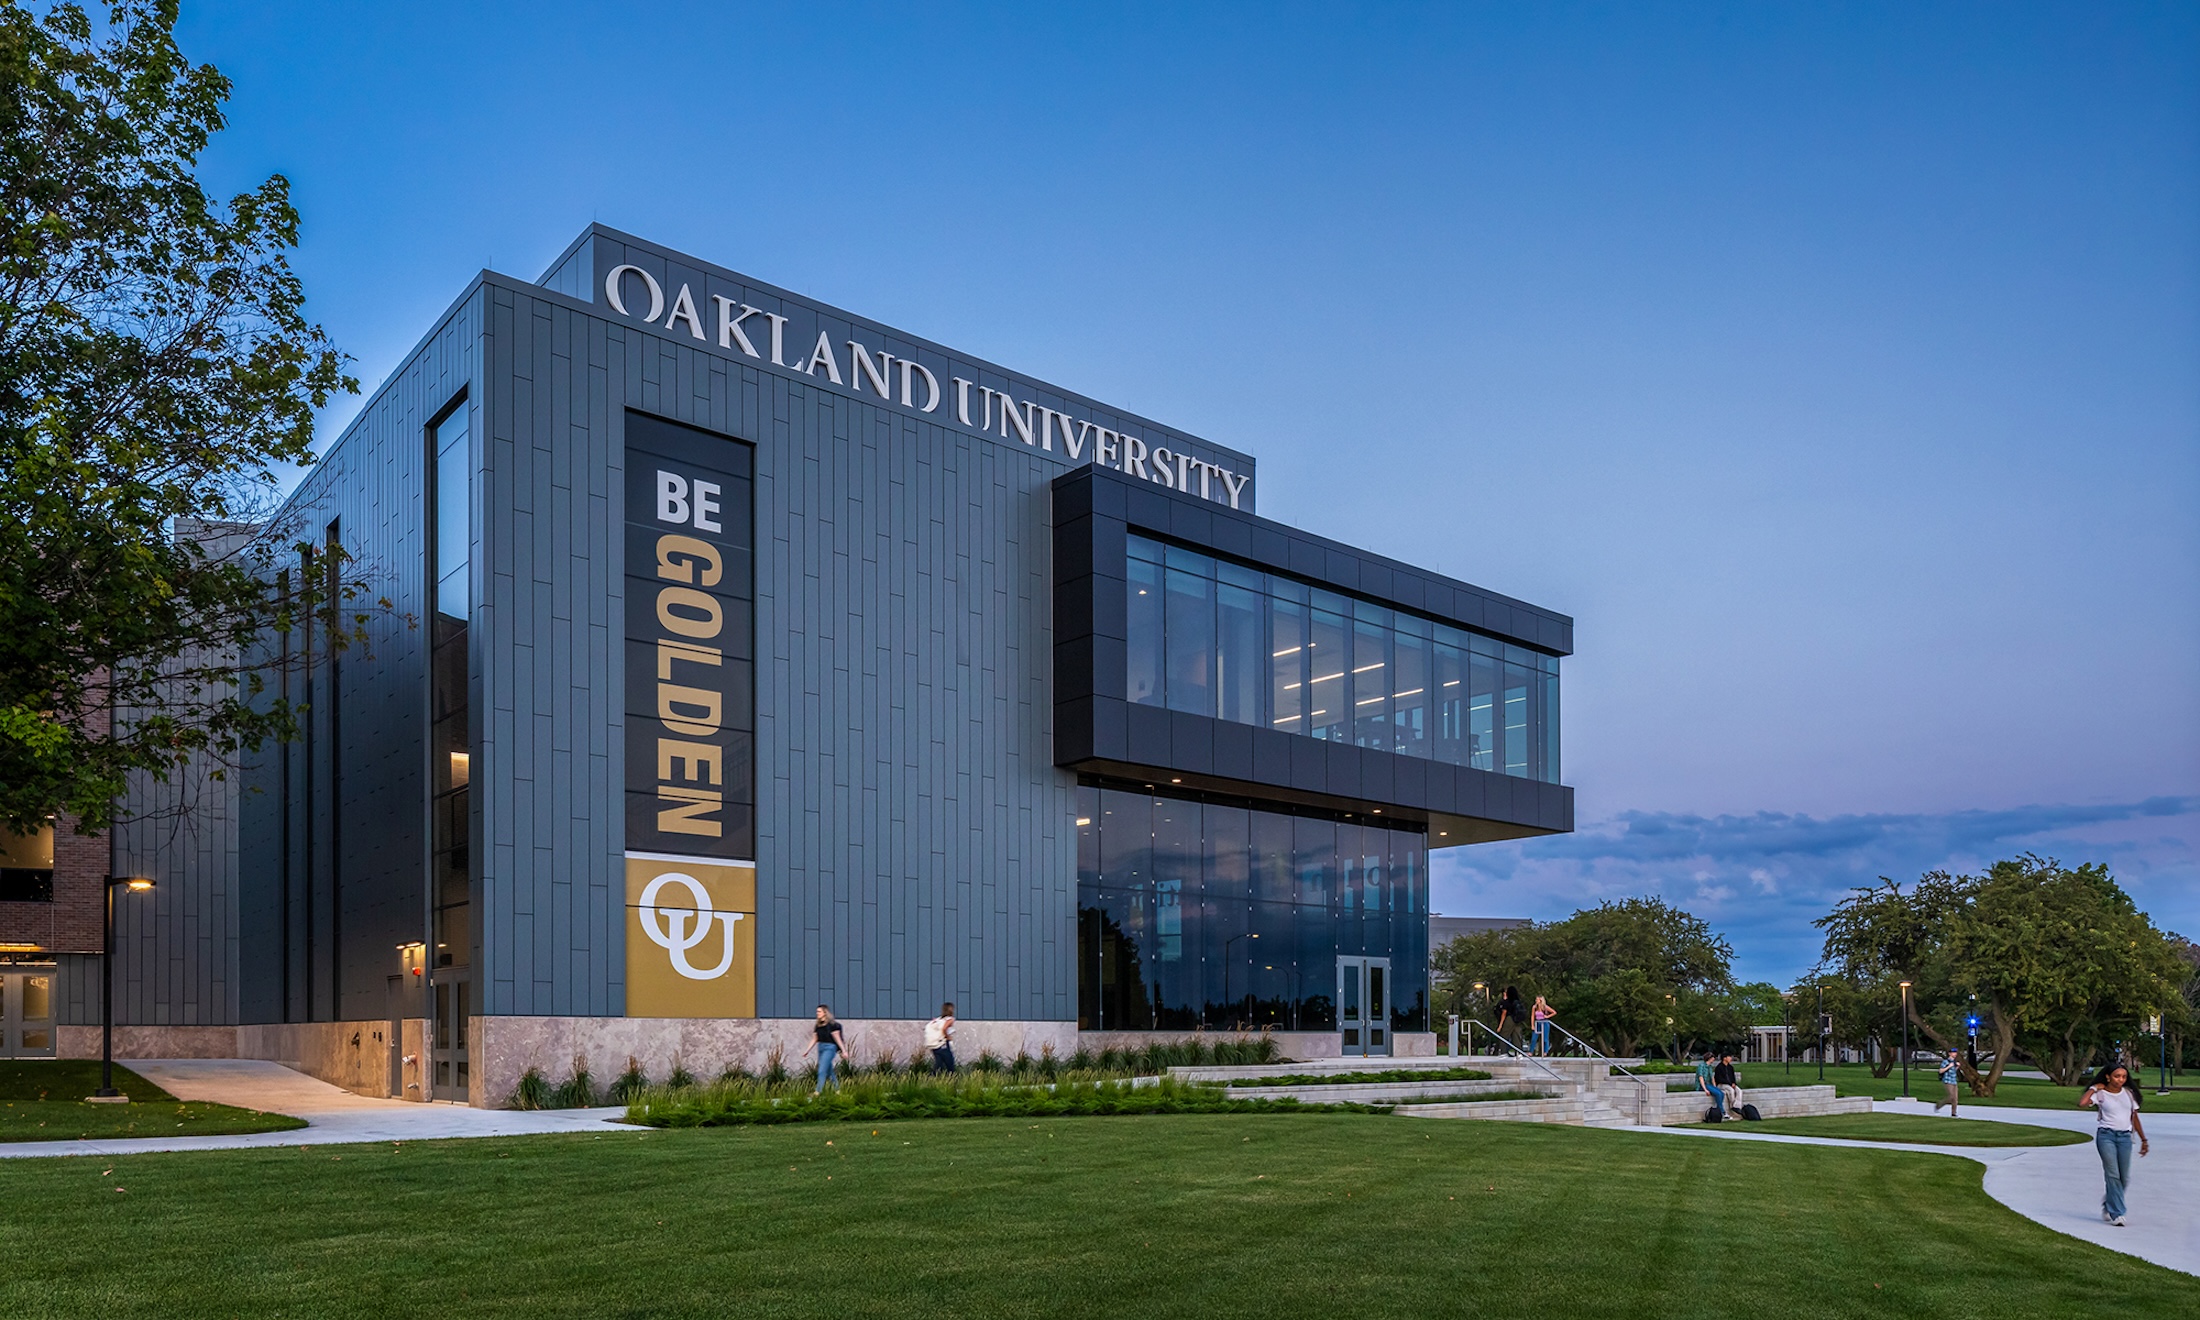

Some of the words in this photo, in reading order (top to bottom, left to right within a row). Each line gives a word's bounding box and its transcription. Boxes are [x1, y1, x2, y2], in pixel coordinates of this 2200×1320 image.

[605, 264, 941, 413] OAKLAND
[953, 376, 1250, 508] UNIVERSITY
[657, 470, 722, 534] BE
[656, 535, 723, 837] GOLDEN
[638, 872, 744, 980] OU
